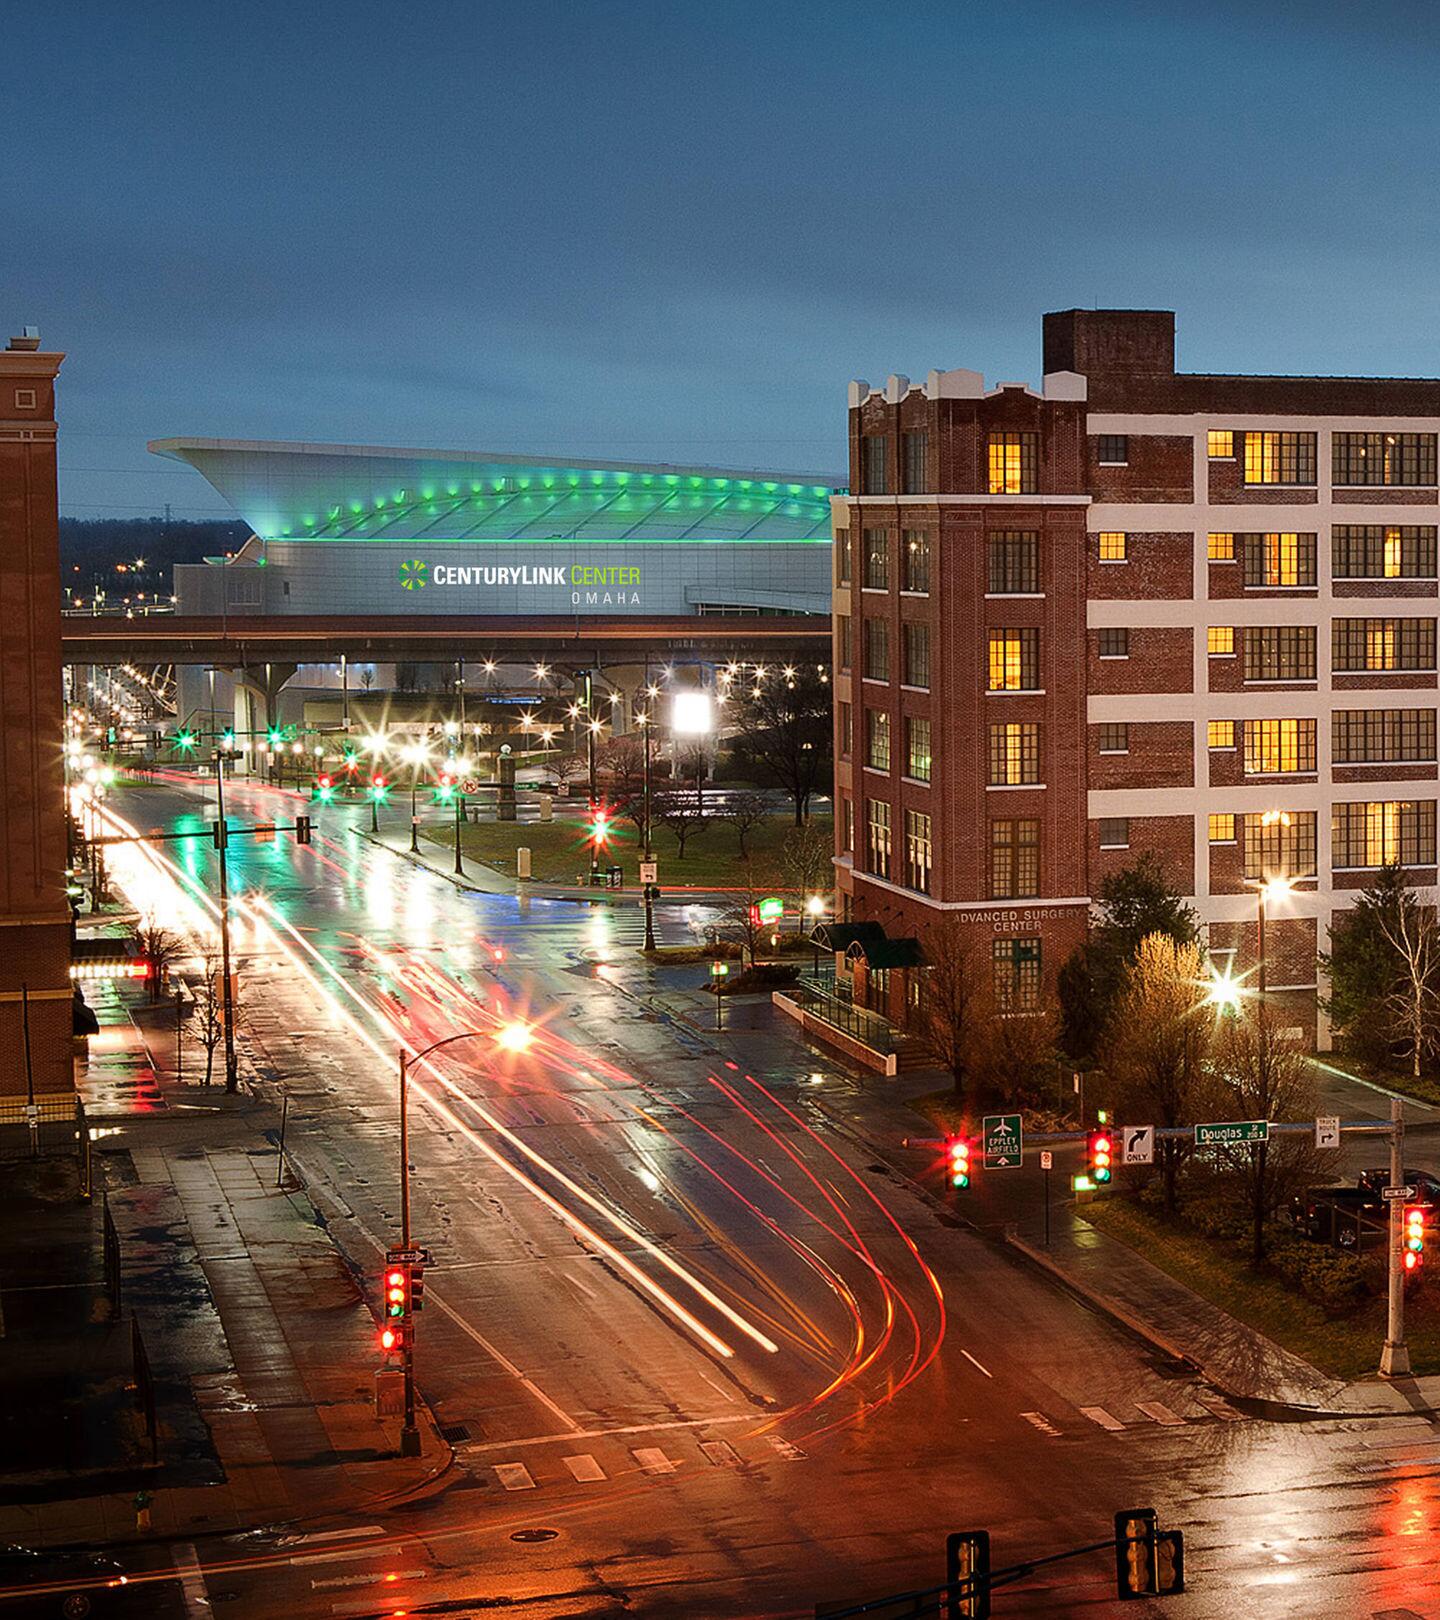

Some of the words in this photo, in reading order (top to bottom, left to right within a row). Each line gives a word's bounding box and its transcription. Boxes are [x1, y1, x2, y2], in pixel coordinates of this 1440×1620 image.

[571, 592, 641, 605] OMAHA
[1023, 908, 1081, 921] SURGERY
[993, 920, 1042, 932] CENTER
[1201, 1127, 1243, 1141] Douglas
[989, 1136, 1017, 1146] EPPLEY
[987, 1144, 1019, 1154] AIRFIELD
[1126, 1153, 1149, 1163] ONLY
